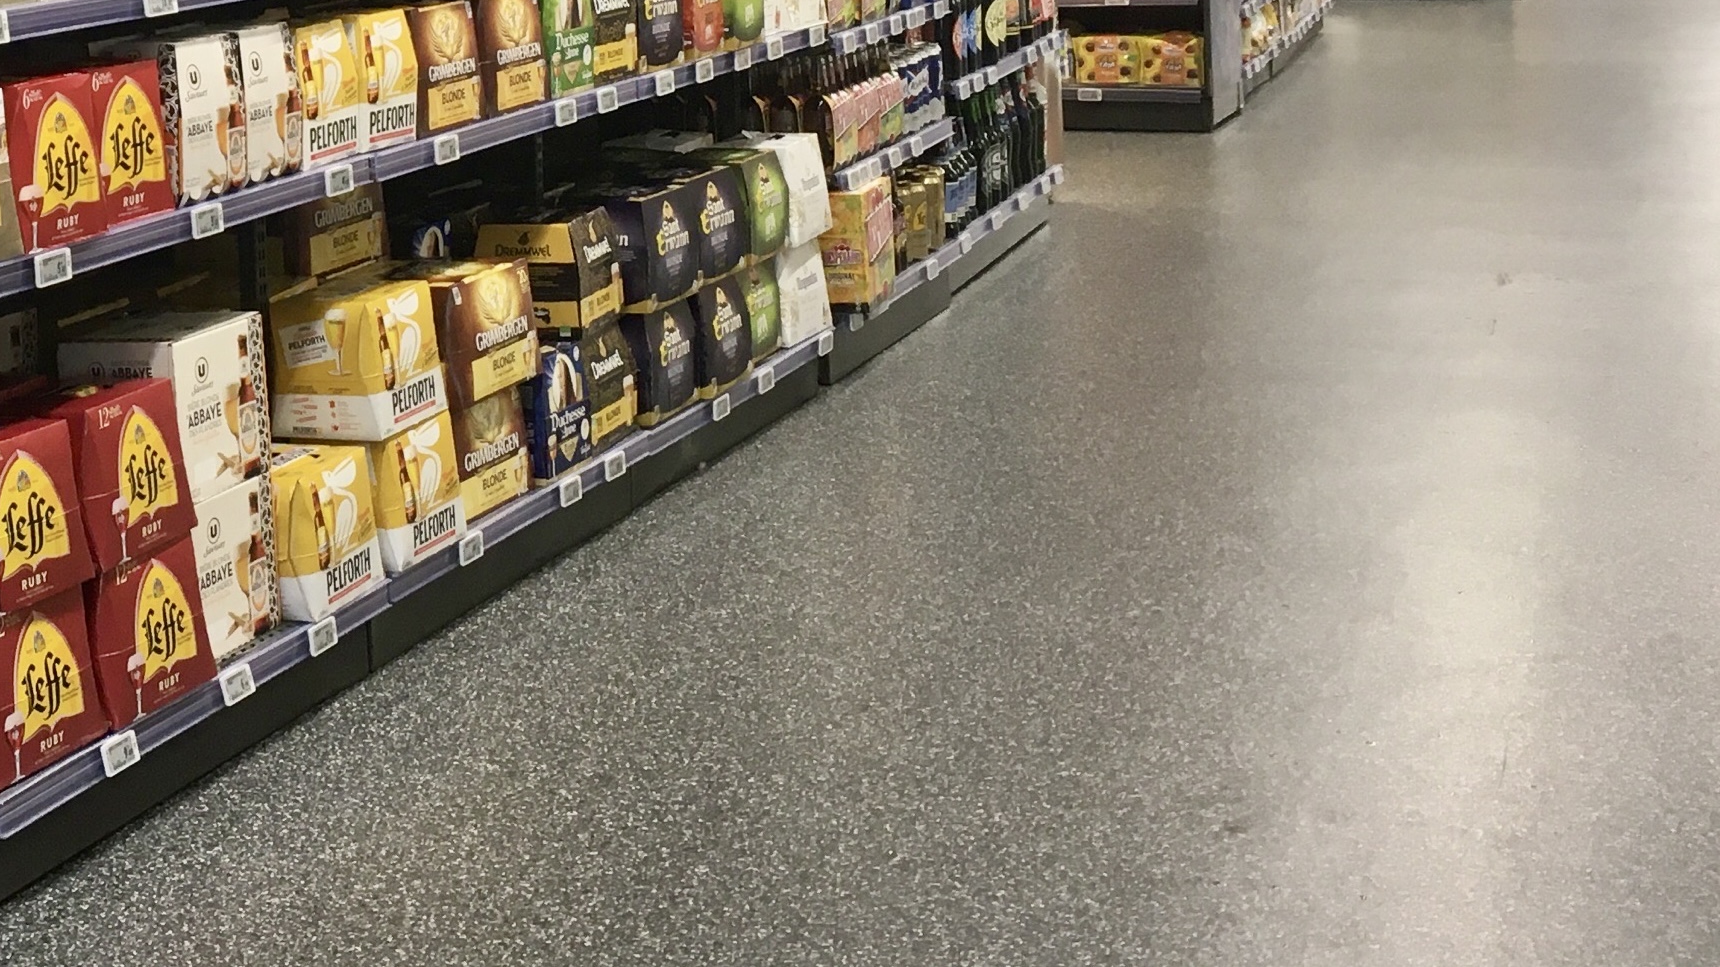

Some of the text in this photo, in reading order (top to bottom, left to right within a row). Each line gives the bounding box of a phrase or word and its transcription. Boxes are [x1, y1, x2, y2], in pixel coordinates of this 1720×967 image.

[441, 90, 466, 105] BLONDE
[112, 115, 156, 177] Leffe
[309, 114, 357, 153] PELFORTH
[44, 133, 90, 199] Leffe
[123, 192, 146, 209] RUBY
[56, 213, 80, 230] RUBY
[391, 376, 437, 417] PELFORTH
[125, 451, 167, 504] Leffe
[1, 492, 57, 561] Leffe
[142, 519, 162, 537] RUBY
[21, 572, 49, 592] RUBY
[200, 561, 234, 591] ABBAYE
[326, 546, 371, 596] PELFORTH
[145, 597, 186, 660] Leffe
[21, 652, 73, 720] Leffe
[159, 673, 181, 694] RUBY
[40, 731, 65, 753] RUBY
